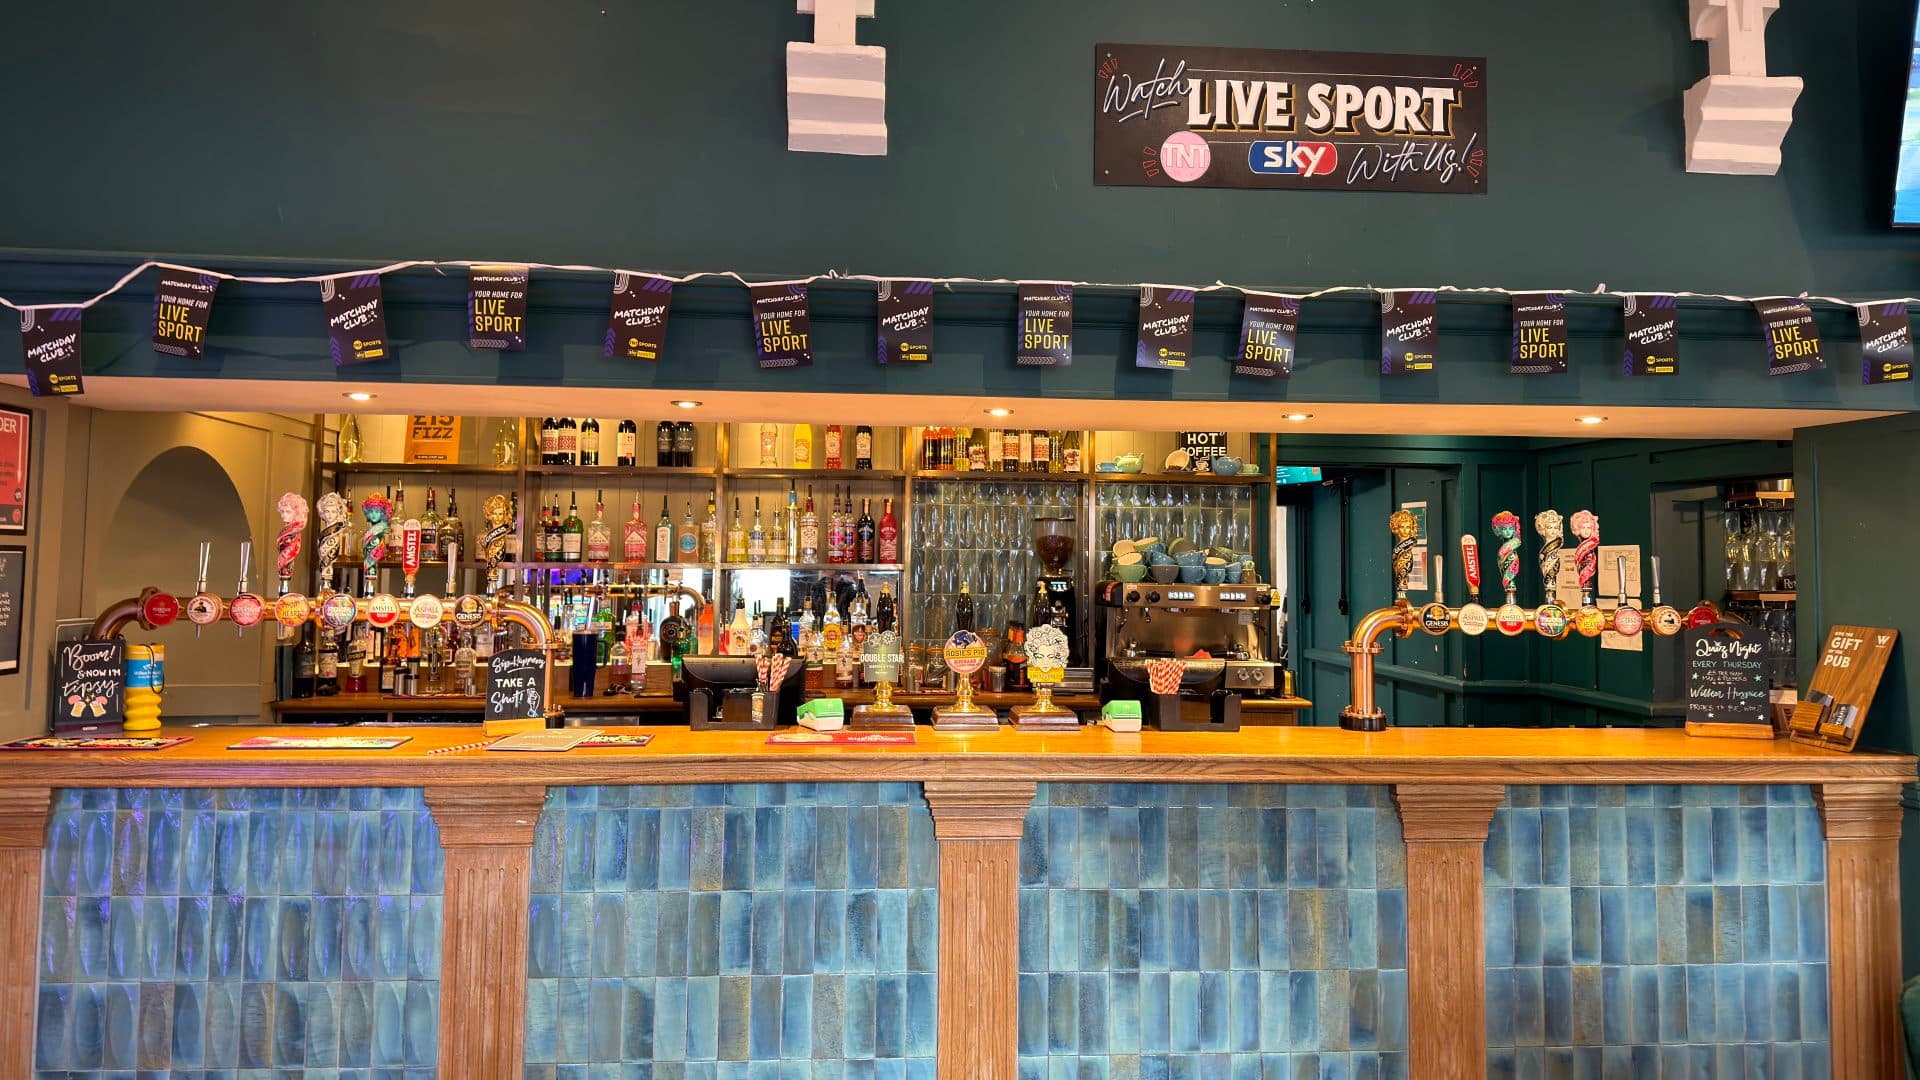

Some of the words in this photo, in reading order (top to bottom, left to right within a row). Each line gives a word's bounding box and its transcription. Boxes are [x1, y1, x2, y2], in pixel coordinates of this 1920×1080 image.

[1103, 58, 1192, 118] Watch
[1188, 78, 1292, 131] LIVE
[1305, 83, 1459, 136] SPORT
[1163, 142, 1209, 169] TNT
[1263, 141, 1326, 177] sky
[1347, 141, 1424, 184] With
[1424, 132, 1477, 183] Us!
[161, 294, 177, 304] YOUR
[177, 297, 193, 307] HOME
[194, 299, 208, 309] FOR
[474, 290, 491, 298] YOUR
[510, 291, 523, 299] FOR
[159, 303, 190, 324] LIVE
[330, 299, 378, 327] MATCHDAY
[475, 299, 506, 315] LIVE
[614, 305, 666, 319] MATCHDAY
[760, 311, 776, 320] YOUR
[777, 311, 792, 319] HOME
[793, 309, 806, 317] FOR
[1025, 310, 1041, 318] YOUR
[343, 315, 368, 330] CLUB
[625, 316, 650, 326] CLUB
[882, 306, 929, 326] MATCHDAY
[1142, 314, 1190, 330] MATCHDAY
[1769, 320, 1784, 328] YOUR
[1784, 318, 1800, 326] HOME
[1801, 316, 1812, 324] FOR
[158, 321, 203, 343] SPORT
[475, 316, 521, 333] SPORT
[761, 320, 792, 336] LIVE
[894, 320, 917, 331] CLUB
[1025, 318, 1054, 333] LIVE
[1154, 327, 1177, 337] CLUB
[1249, 320, 1264, 328] YOUR
[1264, 321, 1282, 330] HOME
[1386, 316, 1433, 337] MATCHDAY
[1628, 320, 1674, 340] MATCHDAY
[763, 334, 808, 352] SPORT
[1024, 334, 1070, 350] SPORT
[1247, 328, 1278, 345] LIVE
[1398, 329, 1423, 341] CLUB
[1520, 327, 1549, 343] LIVE
[1640, 333, 1664, 345] CLUB
[1771, 326, 1802, 344] LIVE
[1865, 326, 1907, 349] MATCHDAY
[27, 333, 76, 358] MATCHDAY
[1244, 344, 1291, 363] SPORT
[1520, 342, 1565, 359] SPORT
[1774, 339, 1819, 360] SPORT
[1877, 341, 1899, 352] CLUB
[40, 348, 65, 362] CLUB
[413, 427, 454, 440] FIZZ
[406, 531, 418, 567] AMSTEL
[1467, 545, 1479, 578] AMSTEL
[1695, 639, 1728, 659] Quiz
[1729, 641, 1762, 659] Night
[1831, 637, 1863, 651] GIFT
[860, 653, 886, 663] DOUBLE
[887, 653, 905, 663] STAR
[1692, 660, 1717, 668] EVERY
[1722, 661, 1762, 669] THURSDAY
[1823, 654, 1851, 668] PUB
[87, 669, 106, 678] NOW
[62, 680, 119, 698] tipsy
[495, 678, 524, 688] TAKE
[527, 677, 536, 687] A
